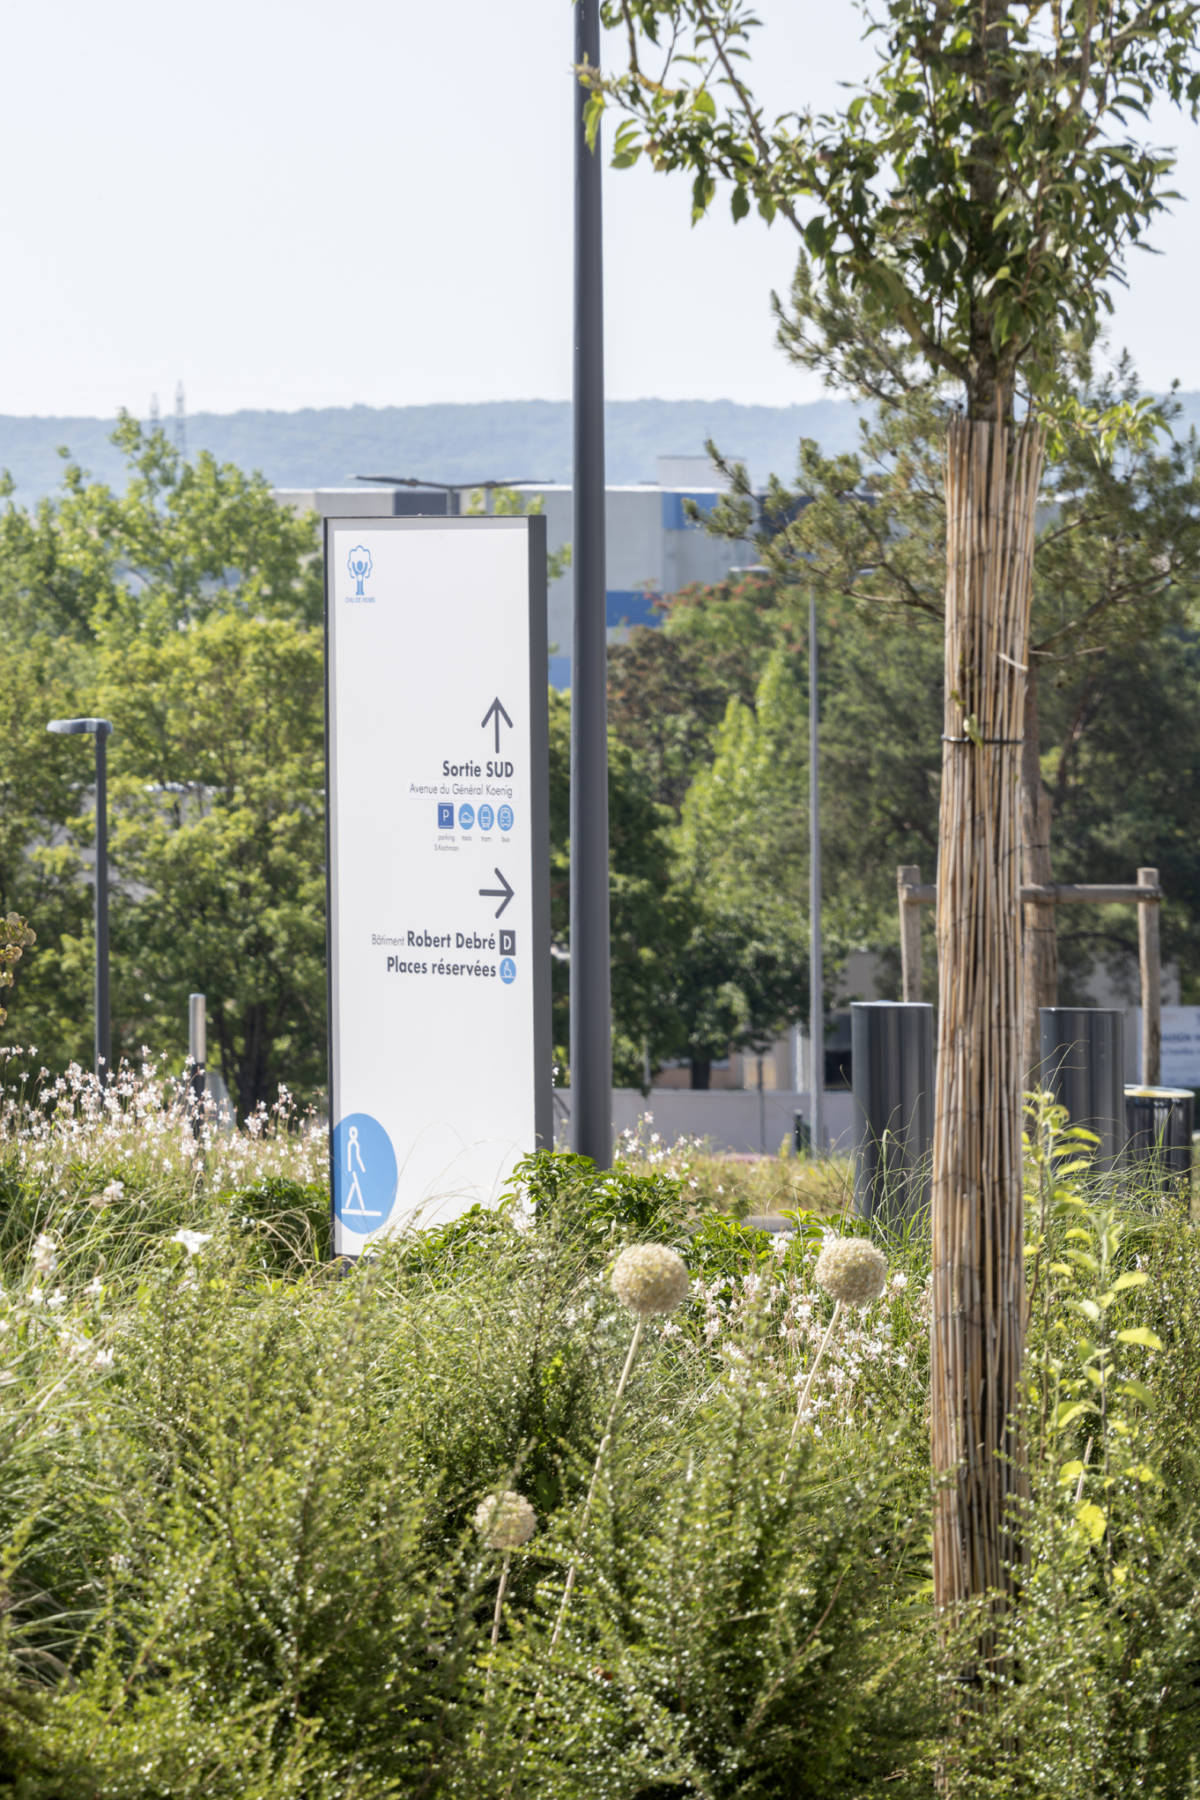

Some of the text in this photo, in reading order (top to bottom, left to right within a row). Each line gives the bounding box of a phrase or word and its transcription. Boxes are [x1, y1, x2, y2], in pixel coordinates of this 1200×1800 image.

[442, 760, 514, 778] Sortie SUD
[409, 783, 513, 799] Avenue du Général Koenig
[371, 929, 512, 950] Bâtiment Robert Debré D
[386, 955, 497, 977] Places réservées
